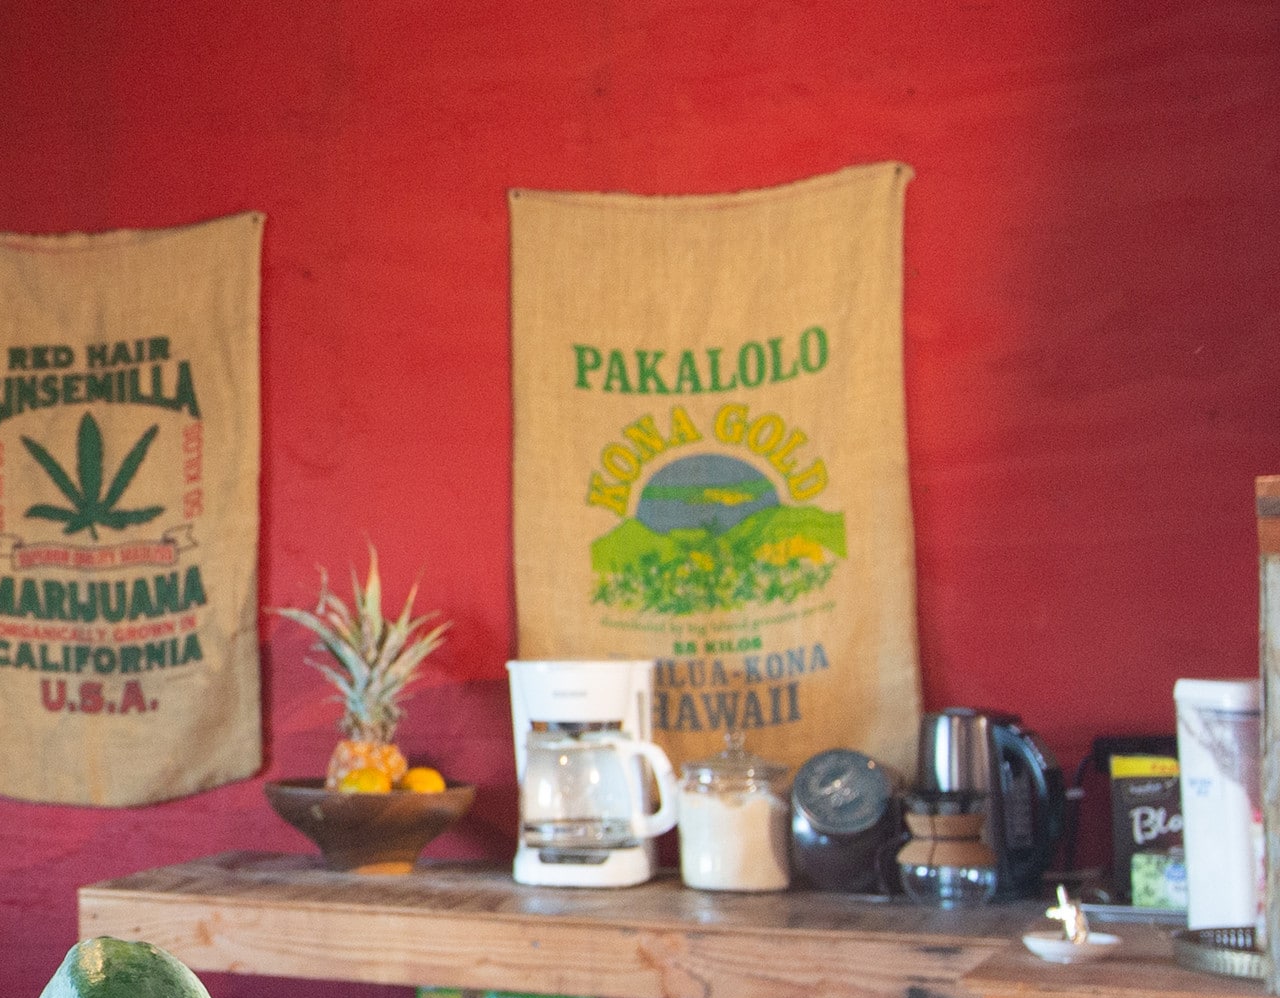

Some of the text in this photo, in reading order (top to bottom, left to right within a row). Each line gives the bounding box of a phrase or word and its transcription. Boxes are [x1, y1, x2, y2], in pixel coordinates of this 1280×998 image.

[7, 336, 171, 370] RED HAIR
[572, 325, 829, 395] PAKALOLO
[587, 402, 830, 517] KONA GOLD
[654, 642, 830, 688] ILUA-KONA
[39, 679, 160, 714] U.S.A.
